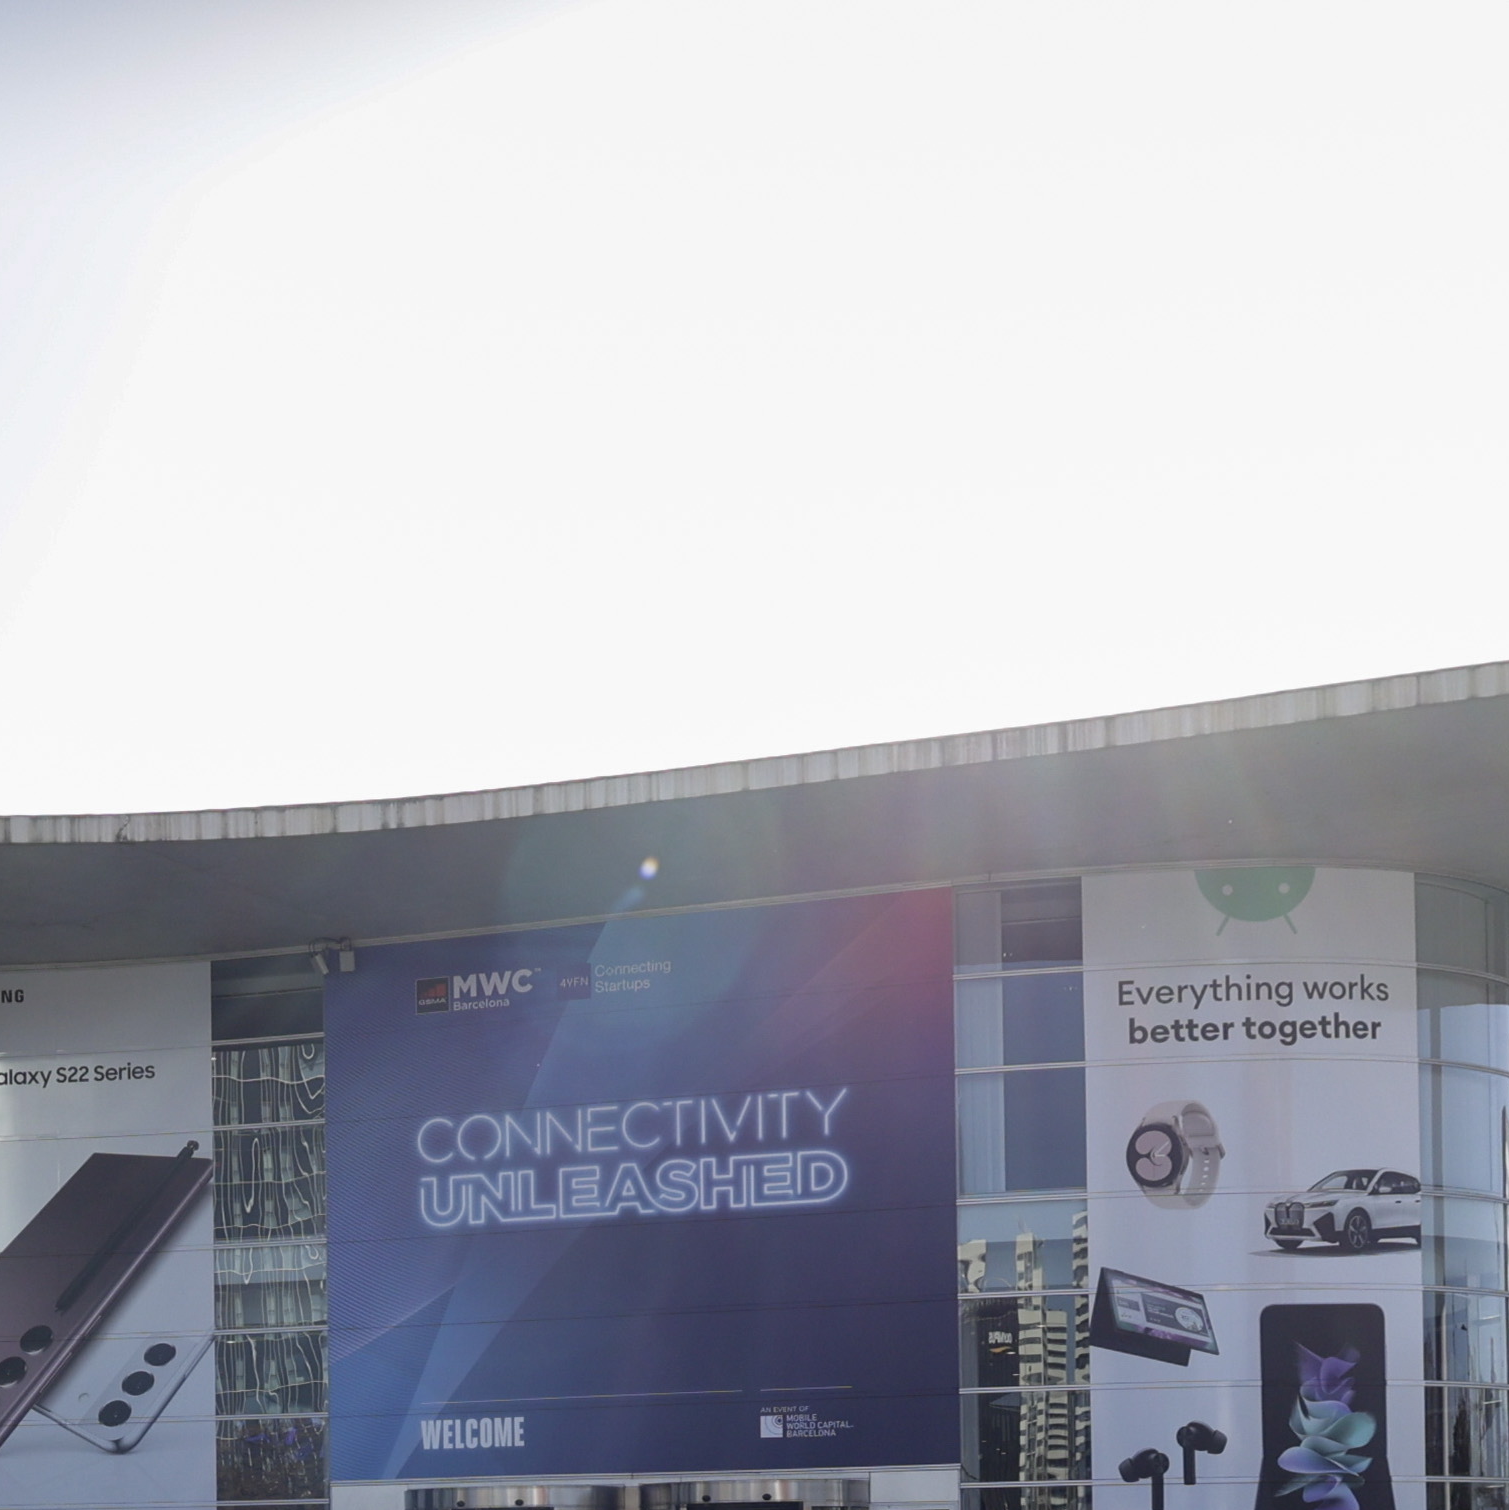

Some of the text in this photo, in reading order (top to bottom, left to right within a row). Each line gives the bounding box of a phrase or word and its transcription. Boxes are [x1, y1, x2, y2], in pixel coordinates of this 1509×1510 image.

[595, 960, 671, 977] Connecting
[595, 978, 650, 993] Startups
[1118, 974, 1390, 1010] Everything works
[453, 998, 510, 1011] Barcelona
[1128, 1012, 1382, 1046] better together
[56, 1066, 89, 1083] S22
[94, 1062, 156, 1081] Series
[417, 1087, 847, 1163] CONNECTIVITY
[420, 1150, 848, 1227] UNLEASHED
[786, 1413, 817, 1422] MOBILE
[786, 1421, 816, 1430] WORLD
[420, 1416, 525, 1450] WELCOME
[786, 1429, 836, 1438] BARCELONA
